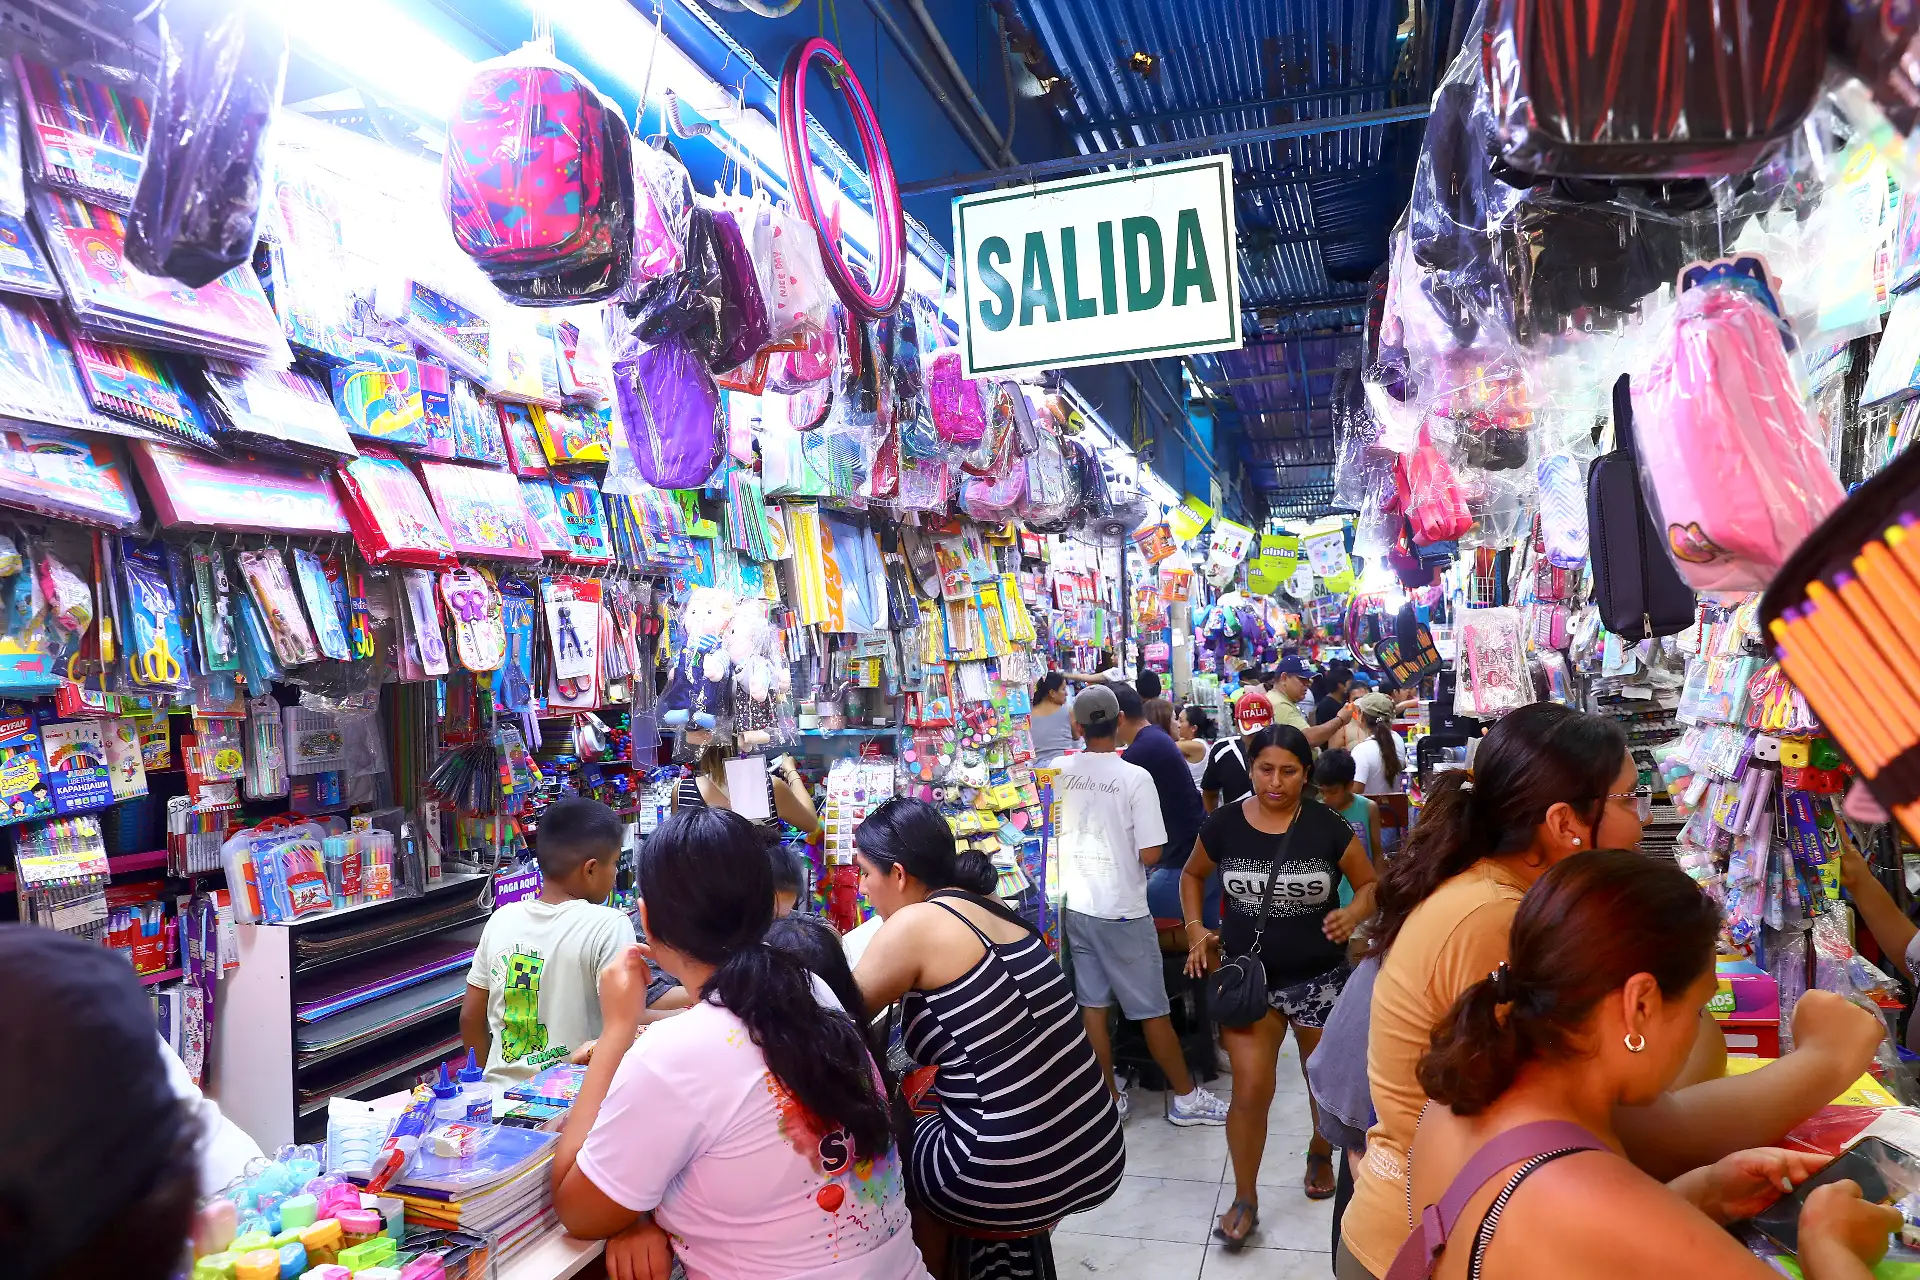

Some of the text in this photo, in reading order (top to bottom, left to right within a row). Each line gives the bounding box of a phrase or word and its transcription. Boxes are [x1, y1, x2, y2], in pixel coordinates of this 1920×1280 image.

[977, 208, 1217, 333] SALIDA
[1262, 546, 1296, 558] alpha
[1242, 708, 1269, 719] ITALIA
[56, 780, 109, 795] КАРАНДАШИ
[66, 775, 97, 785] ЦВЕТНЫЕ
[1062, 774, 1120, 795] Nadie sabe
[498, 873, 538, 896] PAGA AQUÍ
[1227, 879, 1325, 898] GUESS
[520, 890, 536, 902] CON
[189, 937, 200, 960] NIKE
[205, 951, 216, 973] NIKE
[526, 1045, 572, 1066] GAME
